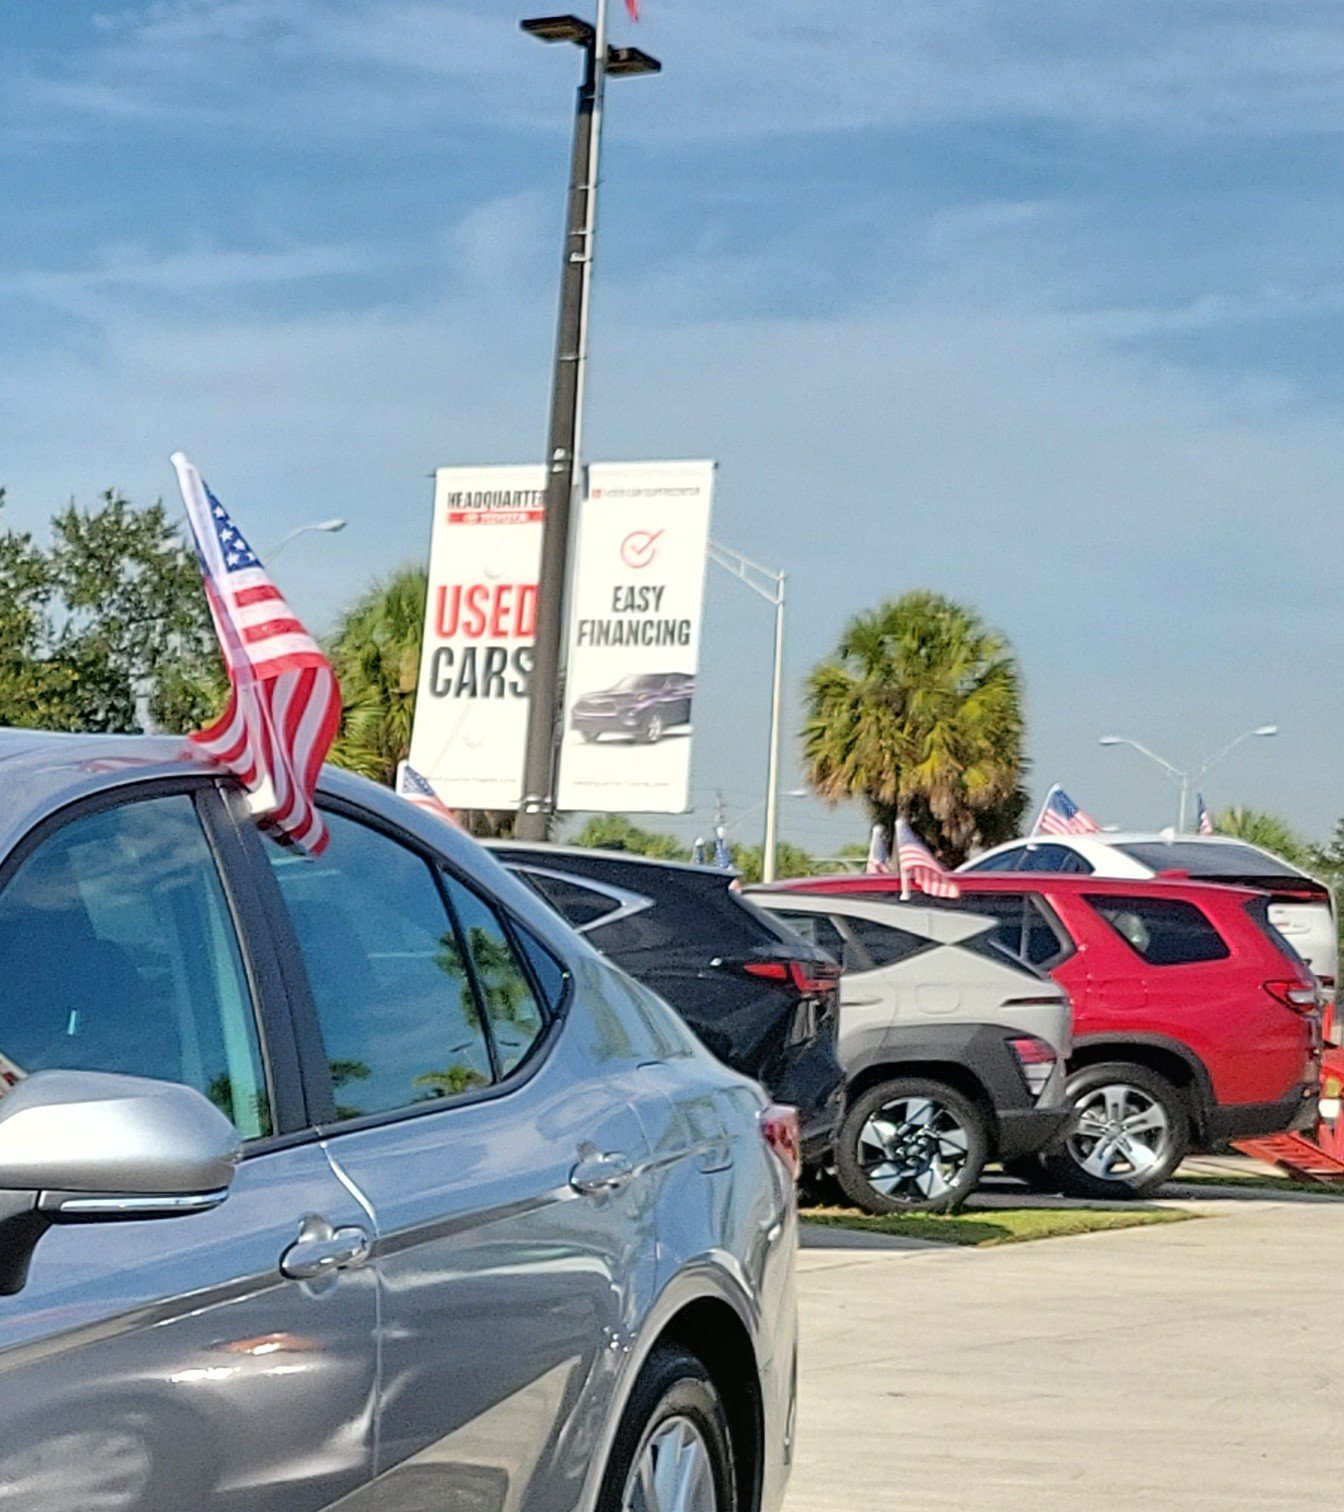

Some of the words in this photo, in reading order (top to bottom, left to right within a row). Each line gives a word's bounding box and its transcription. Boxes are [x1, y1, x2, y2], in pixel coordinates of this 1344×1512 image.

[434, 583, 539, 638] USED
[611, 584, 665, 613] EASY
[576, 619, 692, 647] FINANCING
[428, 645, 534, 699] CARS
